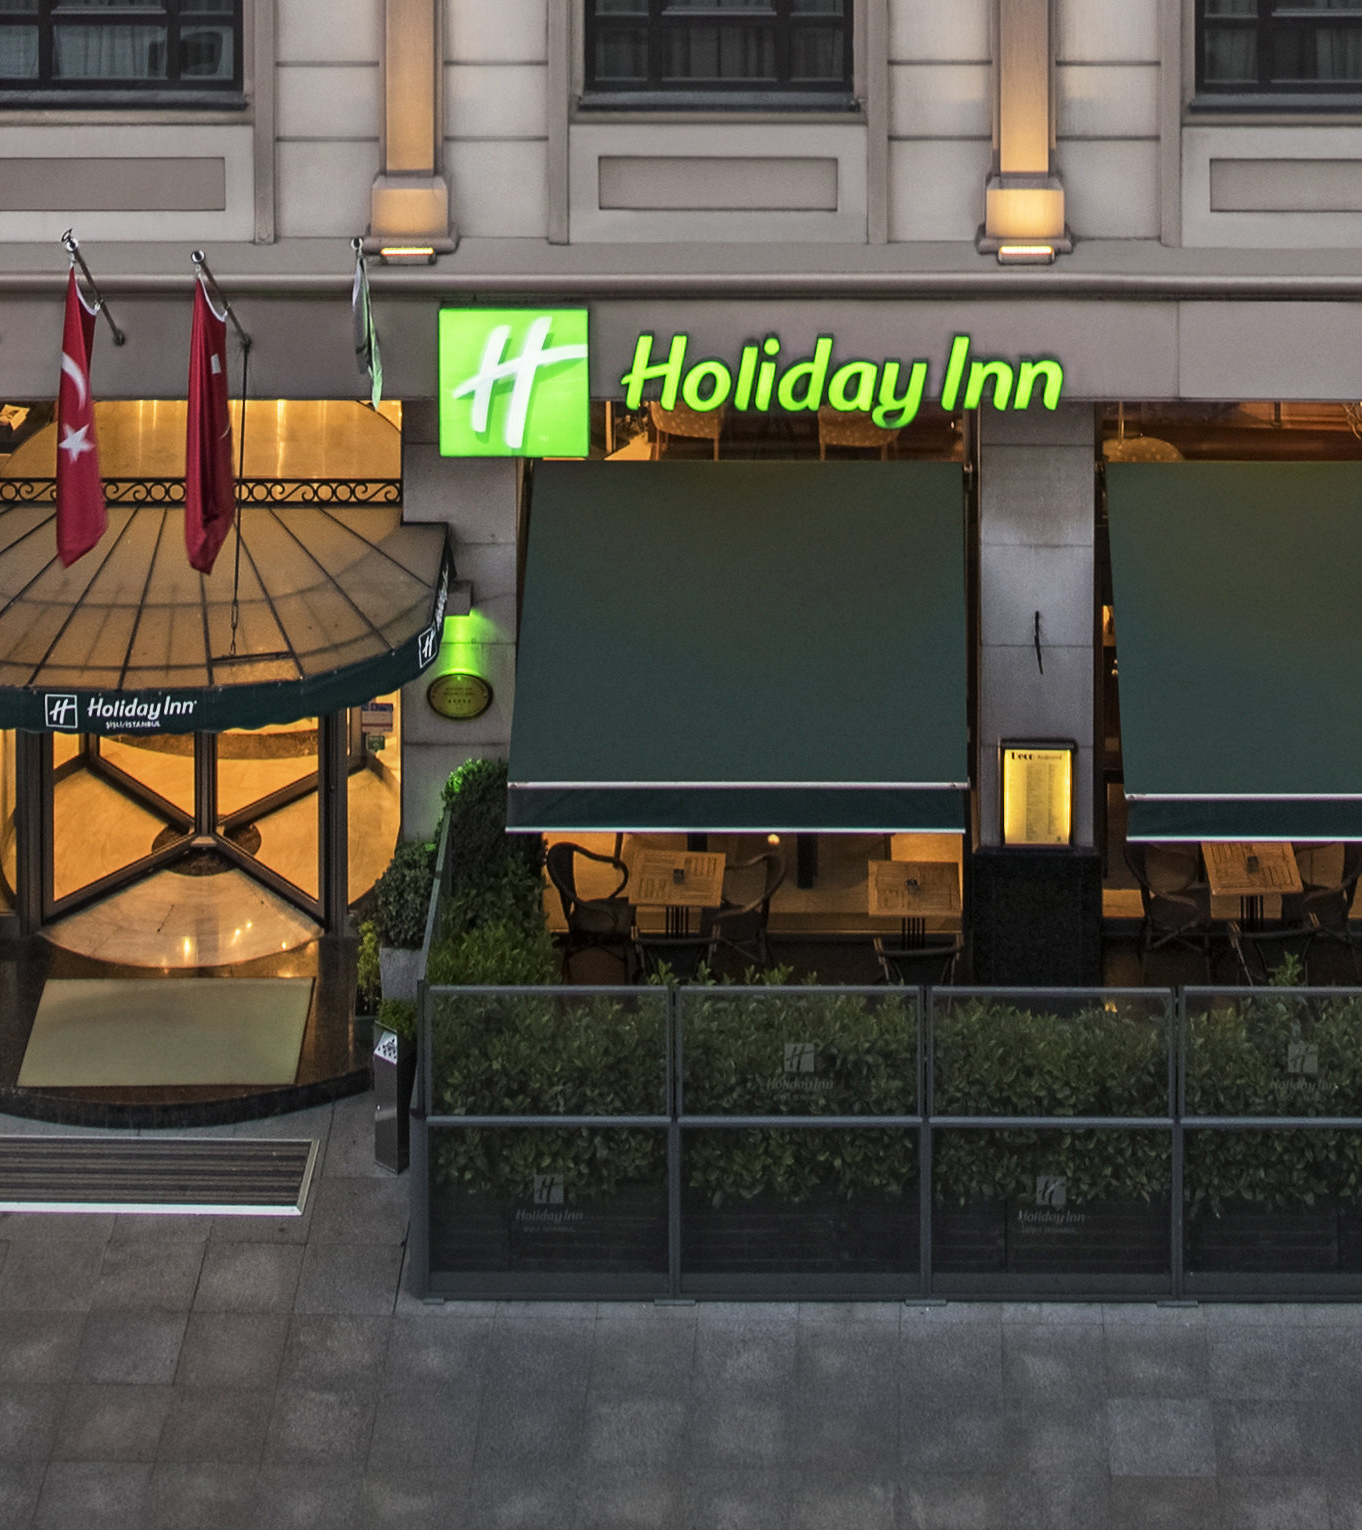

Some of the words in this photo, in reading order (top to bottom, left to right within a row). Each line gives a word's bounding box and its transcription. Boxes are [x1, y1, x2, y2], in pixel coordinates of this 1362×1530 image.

[620, 333, 928, 430] Holiday
[941, 334, 1065, 412] Inn
[87, 696, 161, 720] Holiday
[163, 695, 194, 716] Inn
